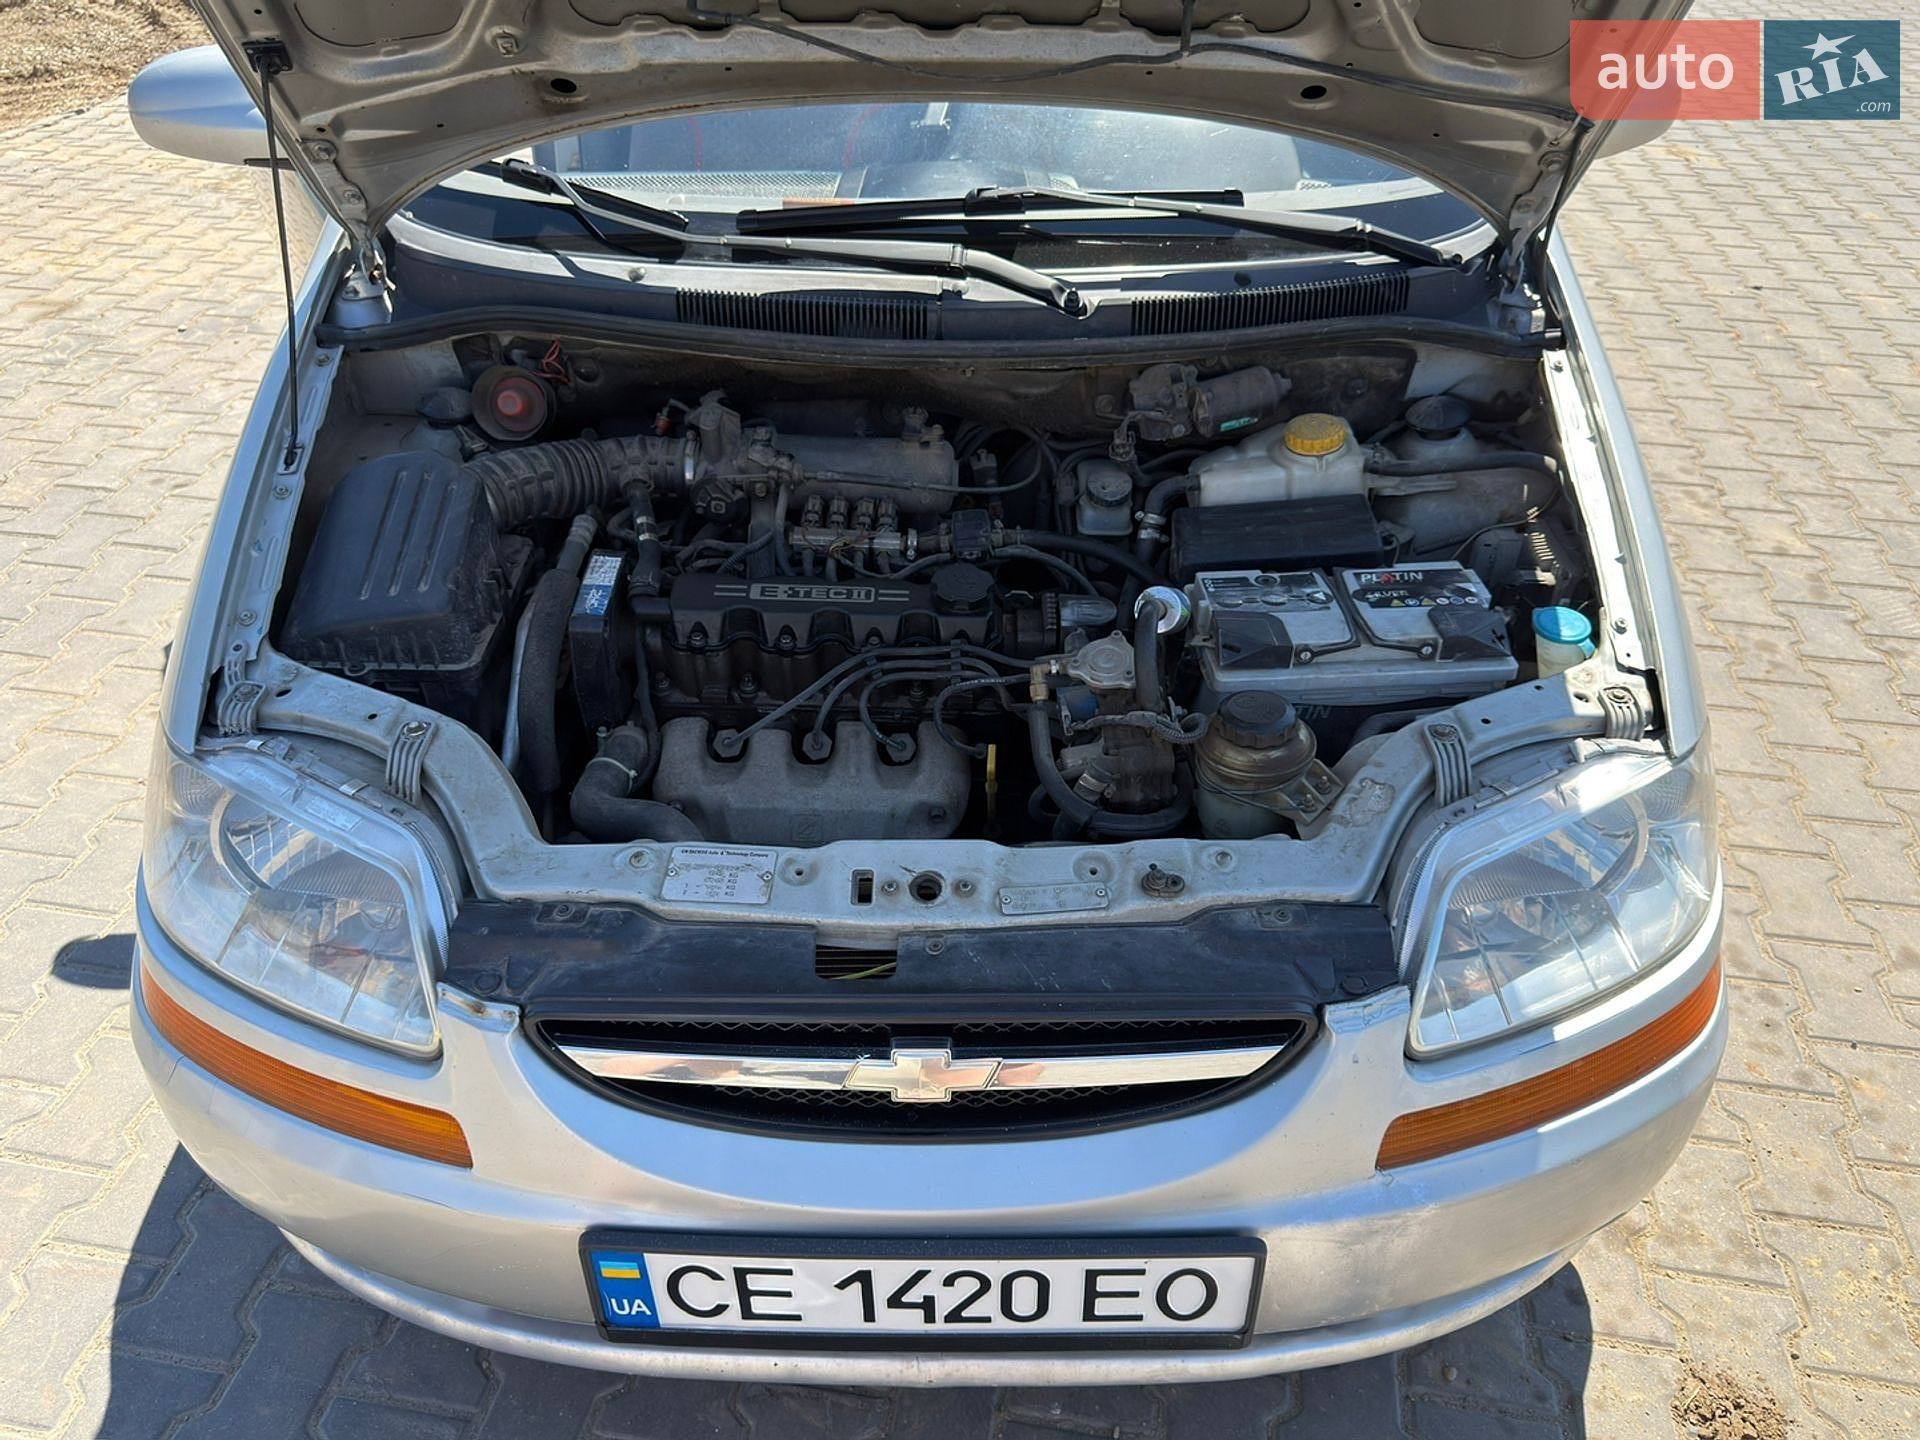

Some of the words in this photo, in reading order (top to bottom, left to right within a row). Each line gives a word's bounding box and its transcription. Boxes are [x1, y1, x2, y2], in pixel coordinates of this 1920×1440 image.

[1360, 571, 1424, 583] PLATIN
[666, 1265, 803, 1321] CE
[833, 1269, 1051, 1324] 1420
[1082, 1267, 1219, 1322] EO
[611, 1298, 652, 1316] UA
